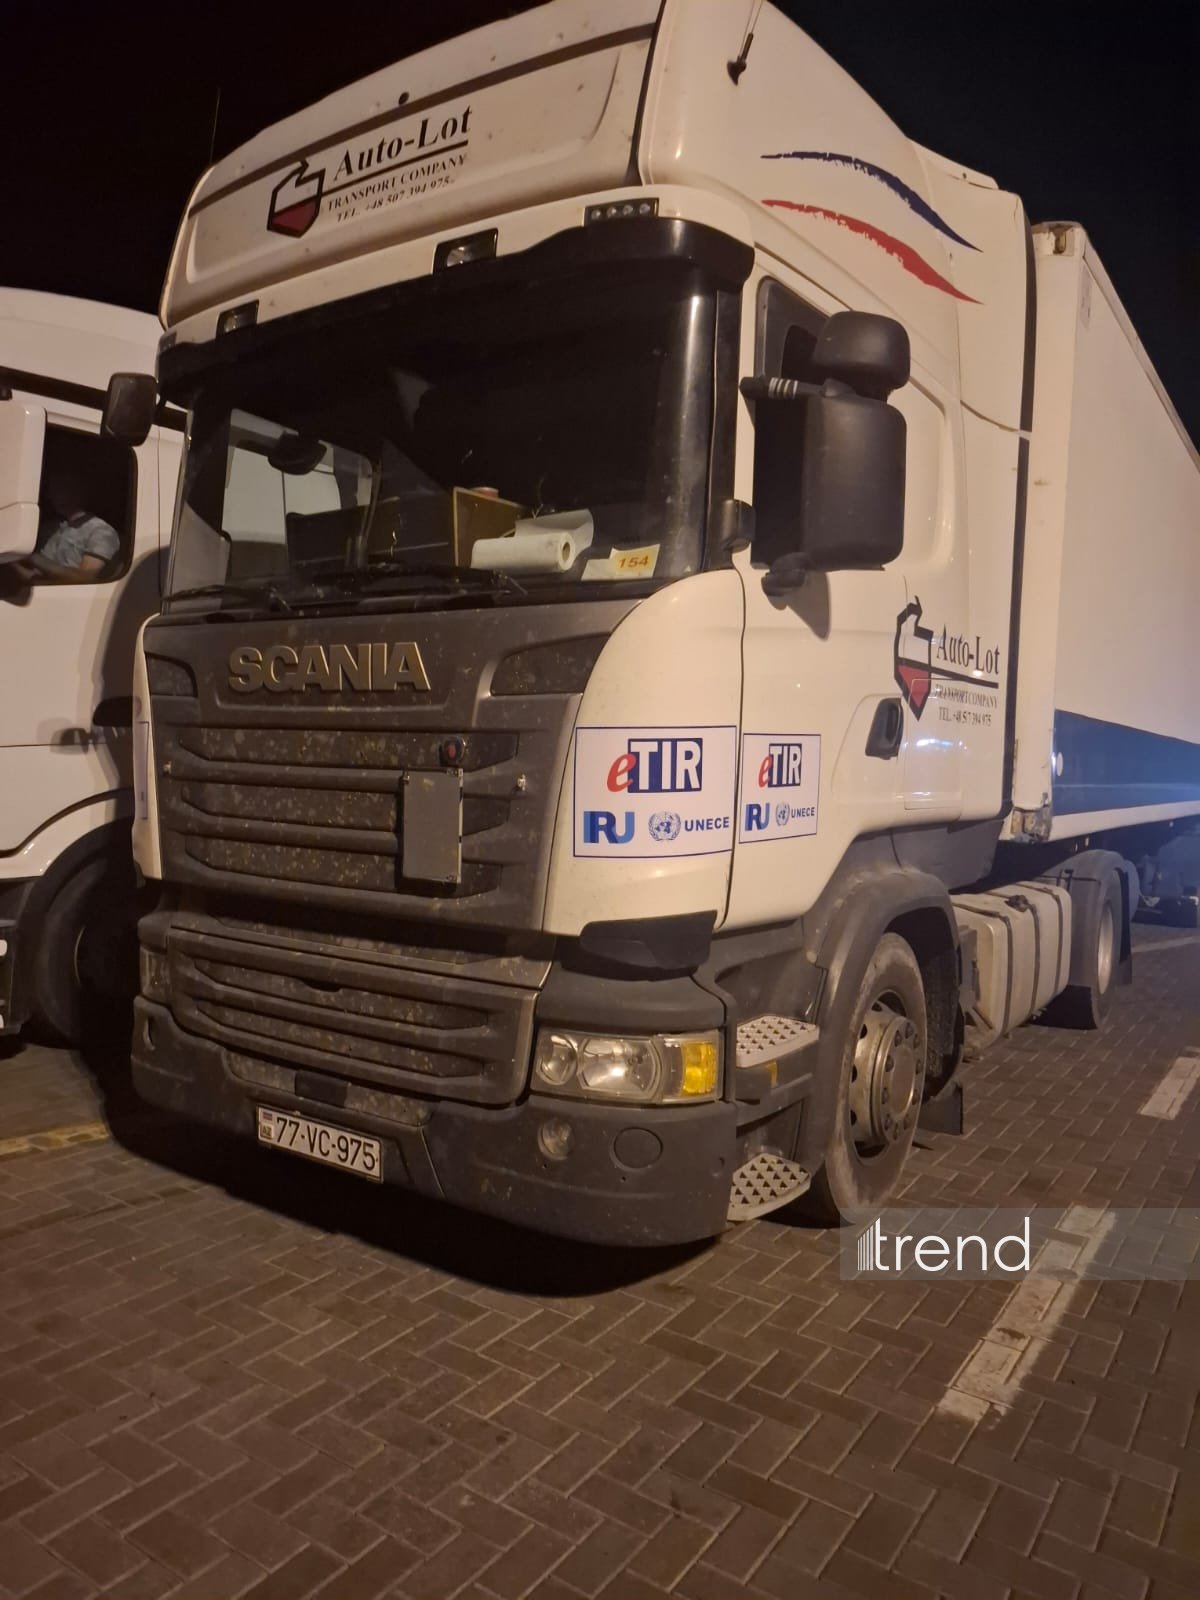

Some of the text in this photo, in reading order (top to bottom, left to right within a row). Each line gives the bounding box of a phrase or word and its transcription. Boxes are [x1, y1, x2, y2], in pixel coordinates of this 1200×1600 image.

[333, 105, 473, 182] Auto-Lot
[327, 153, 468, 212] TRANSPORT COMPANY
[618, 555, 649, 569] 154
[228, 641, 432, 693] SCANIA
[936, 623, 1000, 675] Auto-Lot
[606, 740, 702, 793] eTIR
[583, 811, 635, 844] IRU
[684, 816, 730, 832] UNECE
[791, 806, 816, 818] UNECE
[277, 1116, 376, 1172] 77-VC-975
